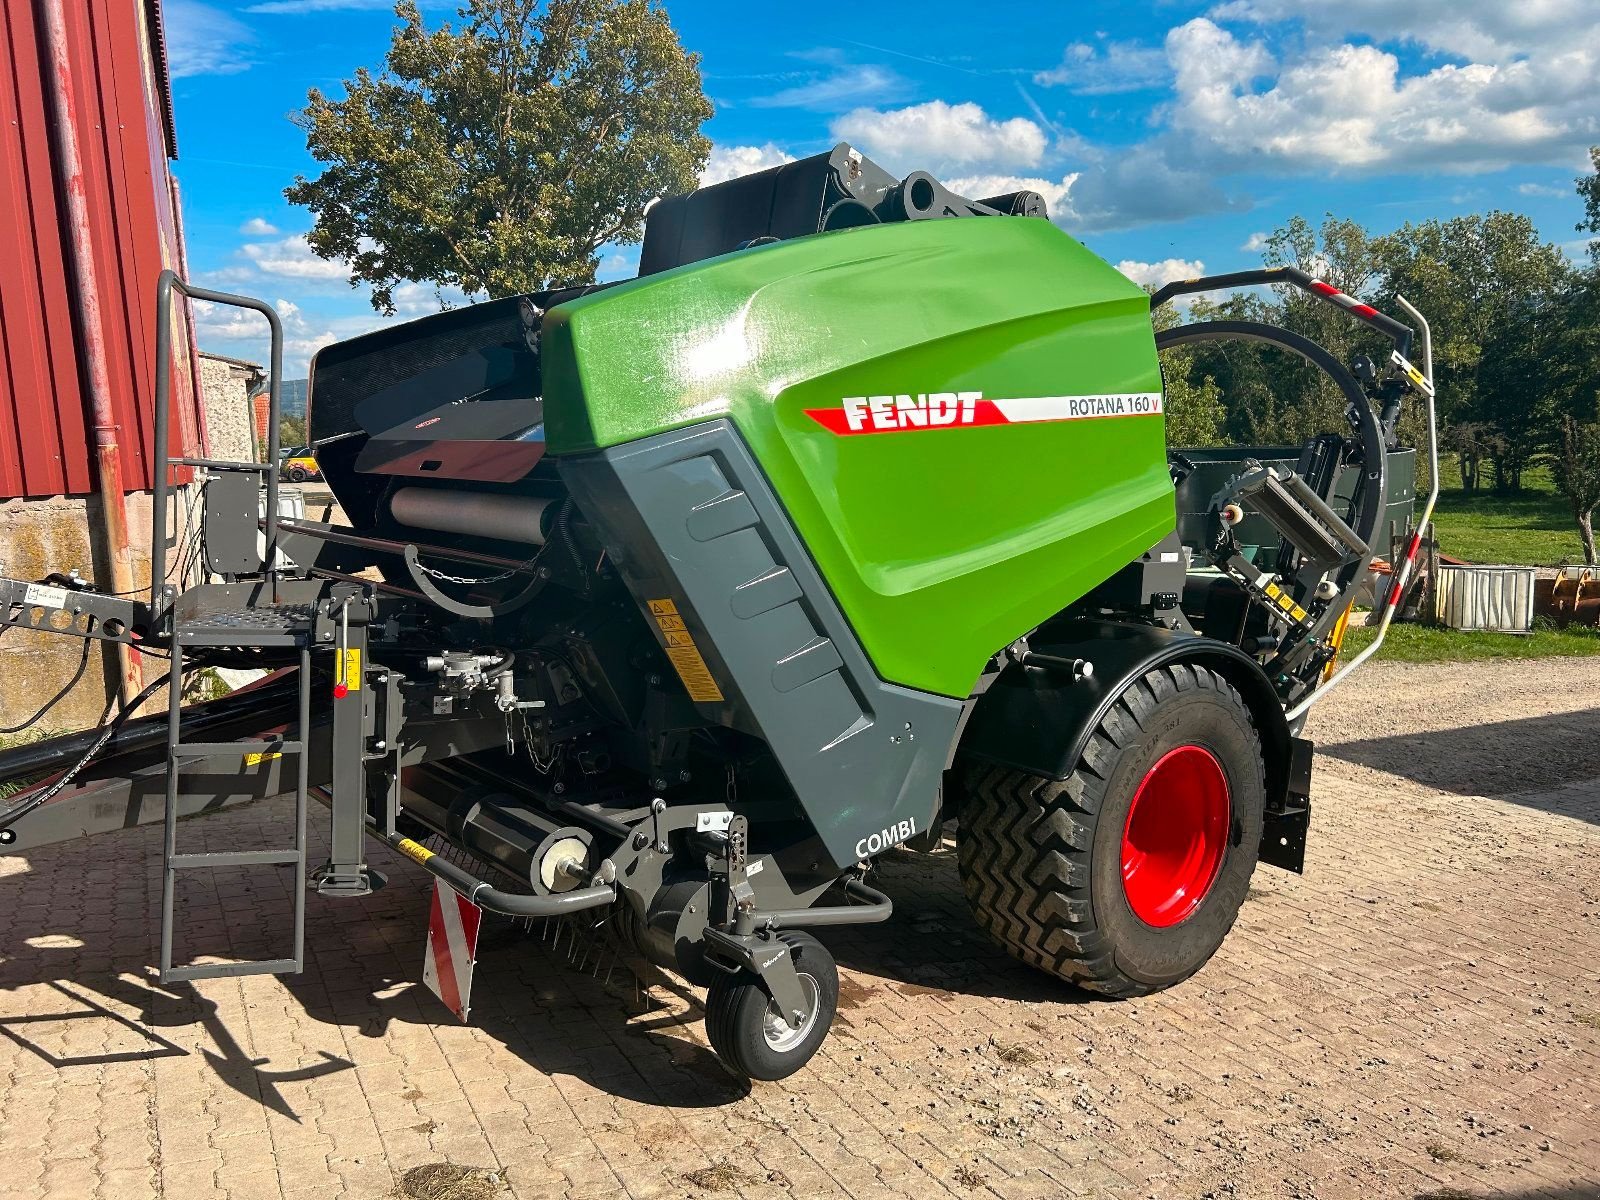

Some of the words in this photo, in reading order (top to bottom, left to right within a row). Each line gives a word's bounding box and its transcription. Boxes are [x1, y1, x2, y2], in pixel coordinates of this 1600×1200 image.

[842, 392, 983, 431] FENDT
[1069, 397, 1125, 416] ROTANA
[1127, 396, 1150, 412] 160
[855, 816, 916, 858] COMBI
